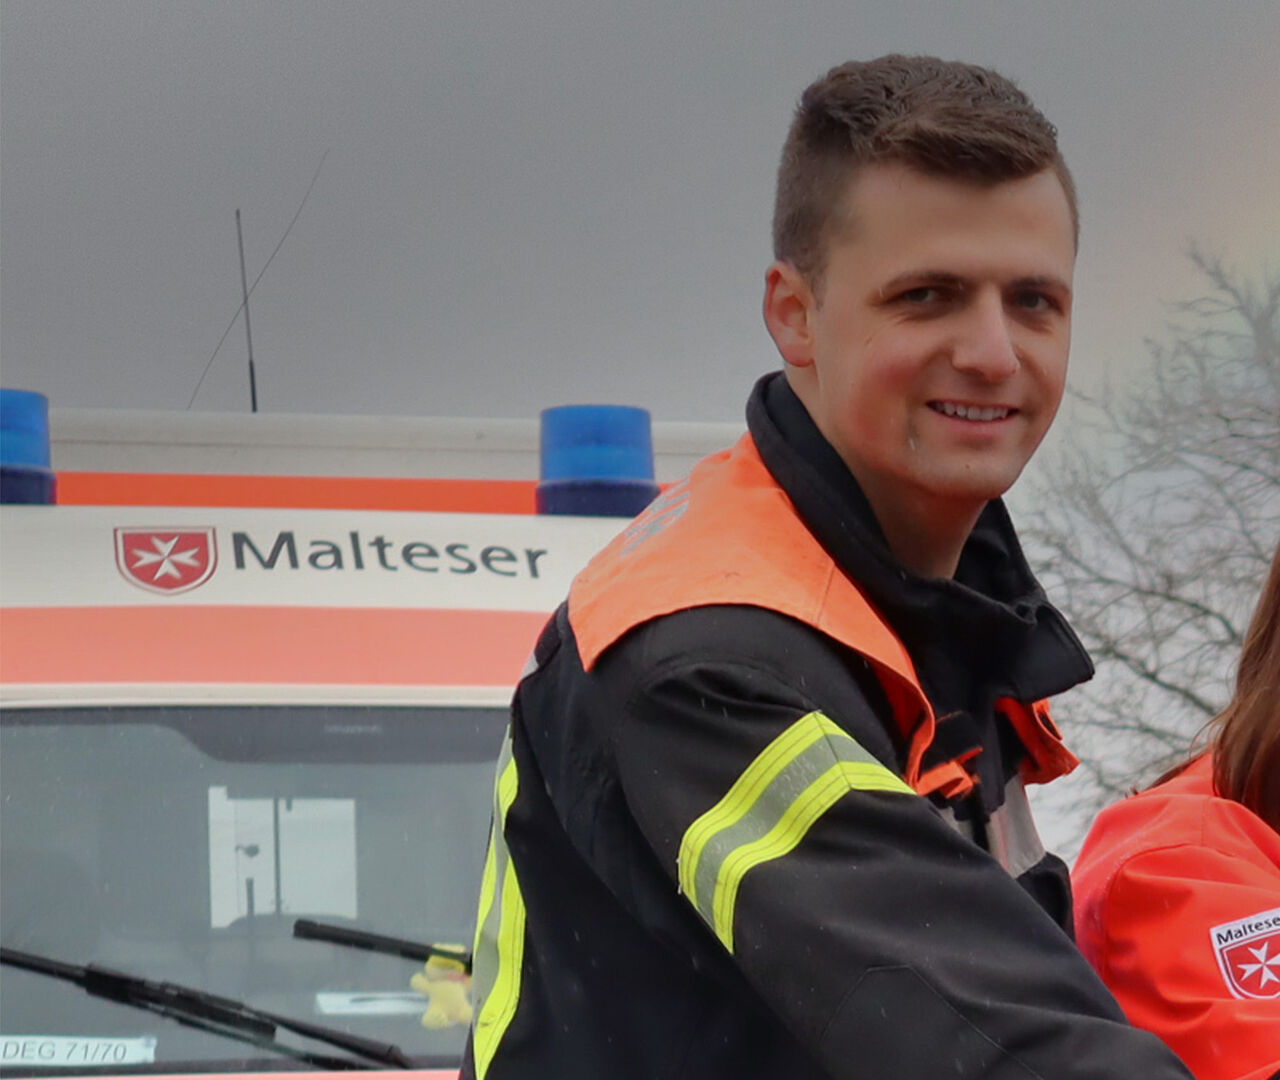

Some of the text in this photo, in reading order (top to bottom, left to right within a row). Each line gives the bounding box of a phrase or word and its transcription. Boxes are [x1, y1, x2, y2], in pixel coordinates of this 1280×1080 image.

[232, 530, 548, 579] Malteser
[2, 1041, 127, 1060] DEG 71/70
